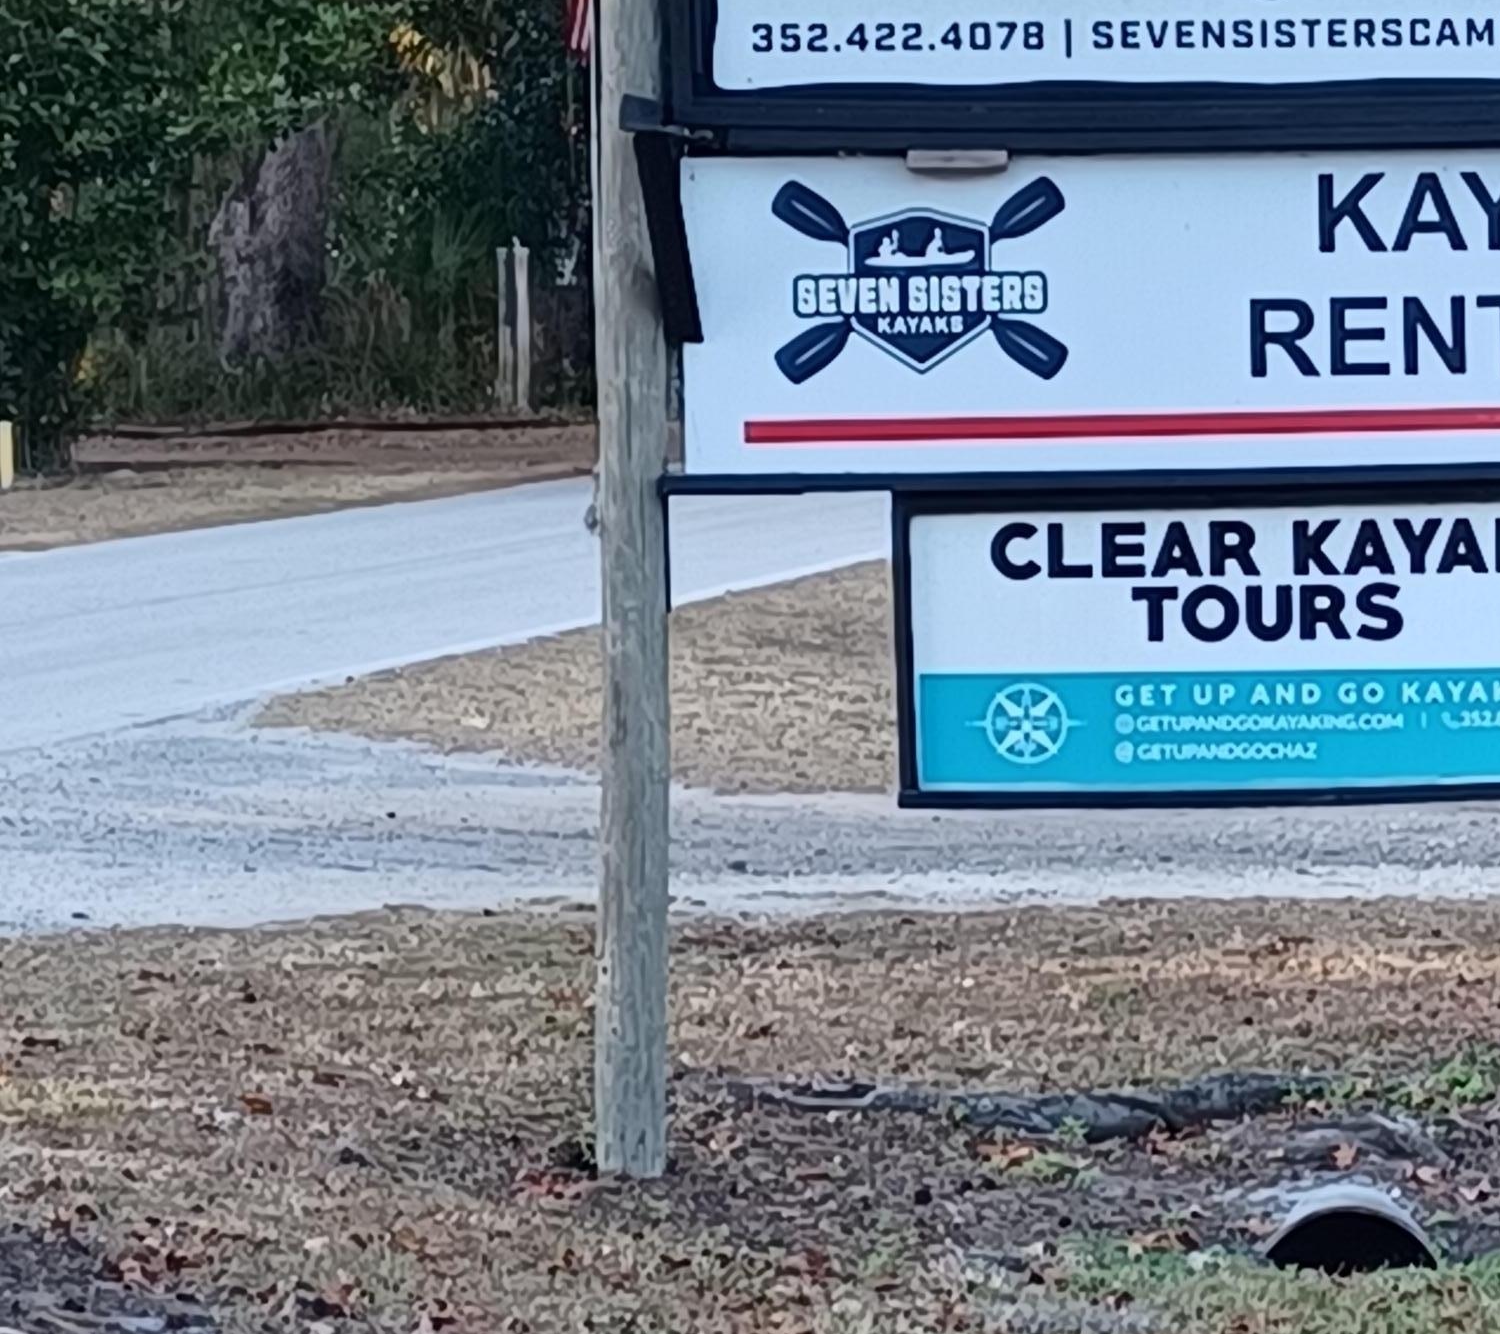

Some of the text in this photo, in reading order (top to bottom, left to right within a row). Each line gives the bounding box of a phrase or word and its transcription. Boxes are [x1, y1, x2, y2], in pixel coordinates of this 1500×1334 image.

[753, 22, 1044, 52] 352.422.4078
[797, 275, 1044, 315] SEVEN SISTERS
[877, 316, 964, 334] KAYAKS
[991, 521, 1260, 580] CLEAR
[1132, 582, 1403, 642] TOURS
[1116, 684, 1176, 706] GET
[1194, 684, 1235, 705] UP
[1251, 683, 1320, 704] AND
[1338, 682, 1384, 704] GO
